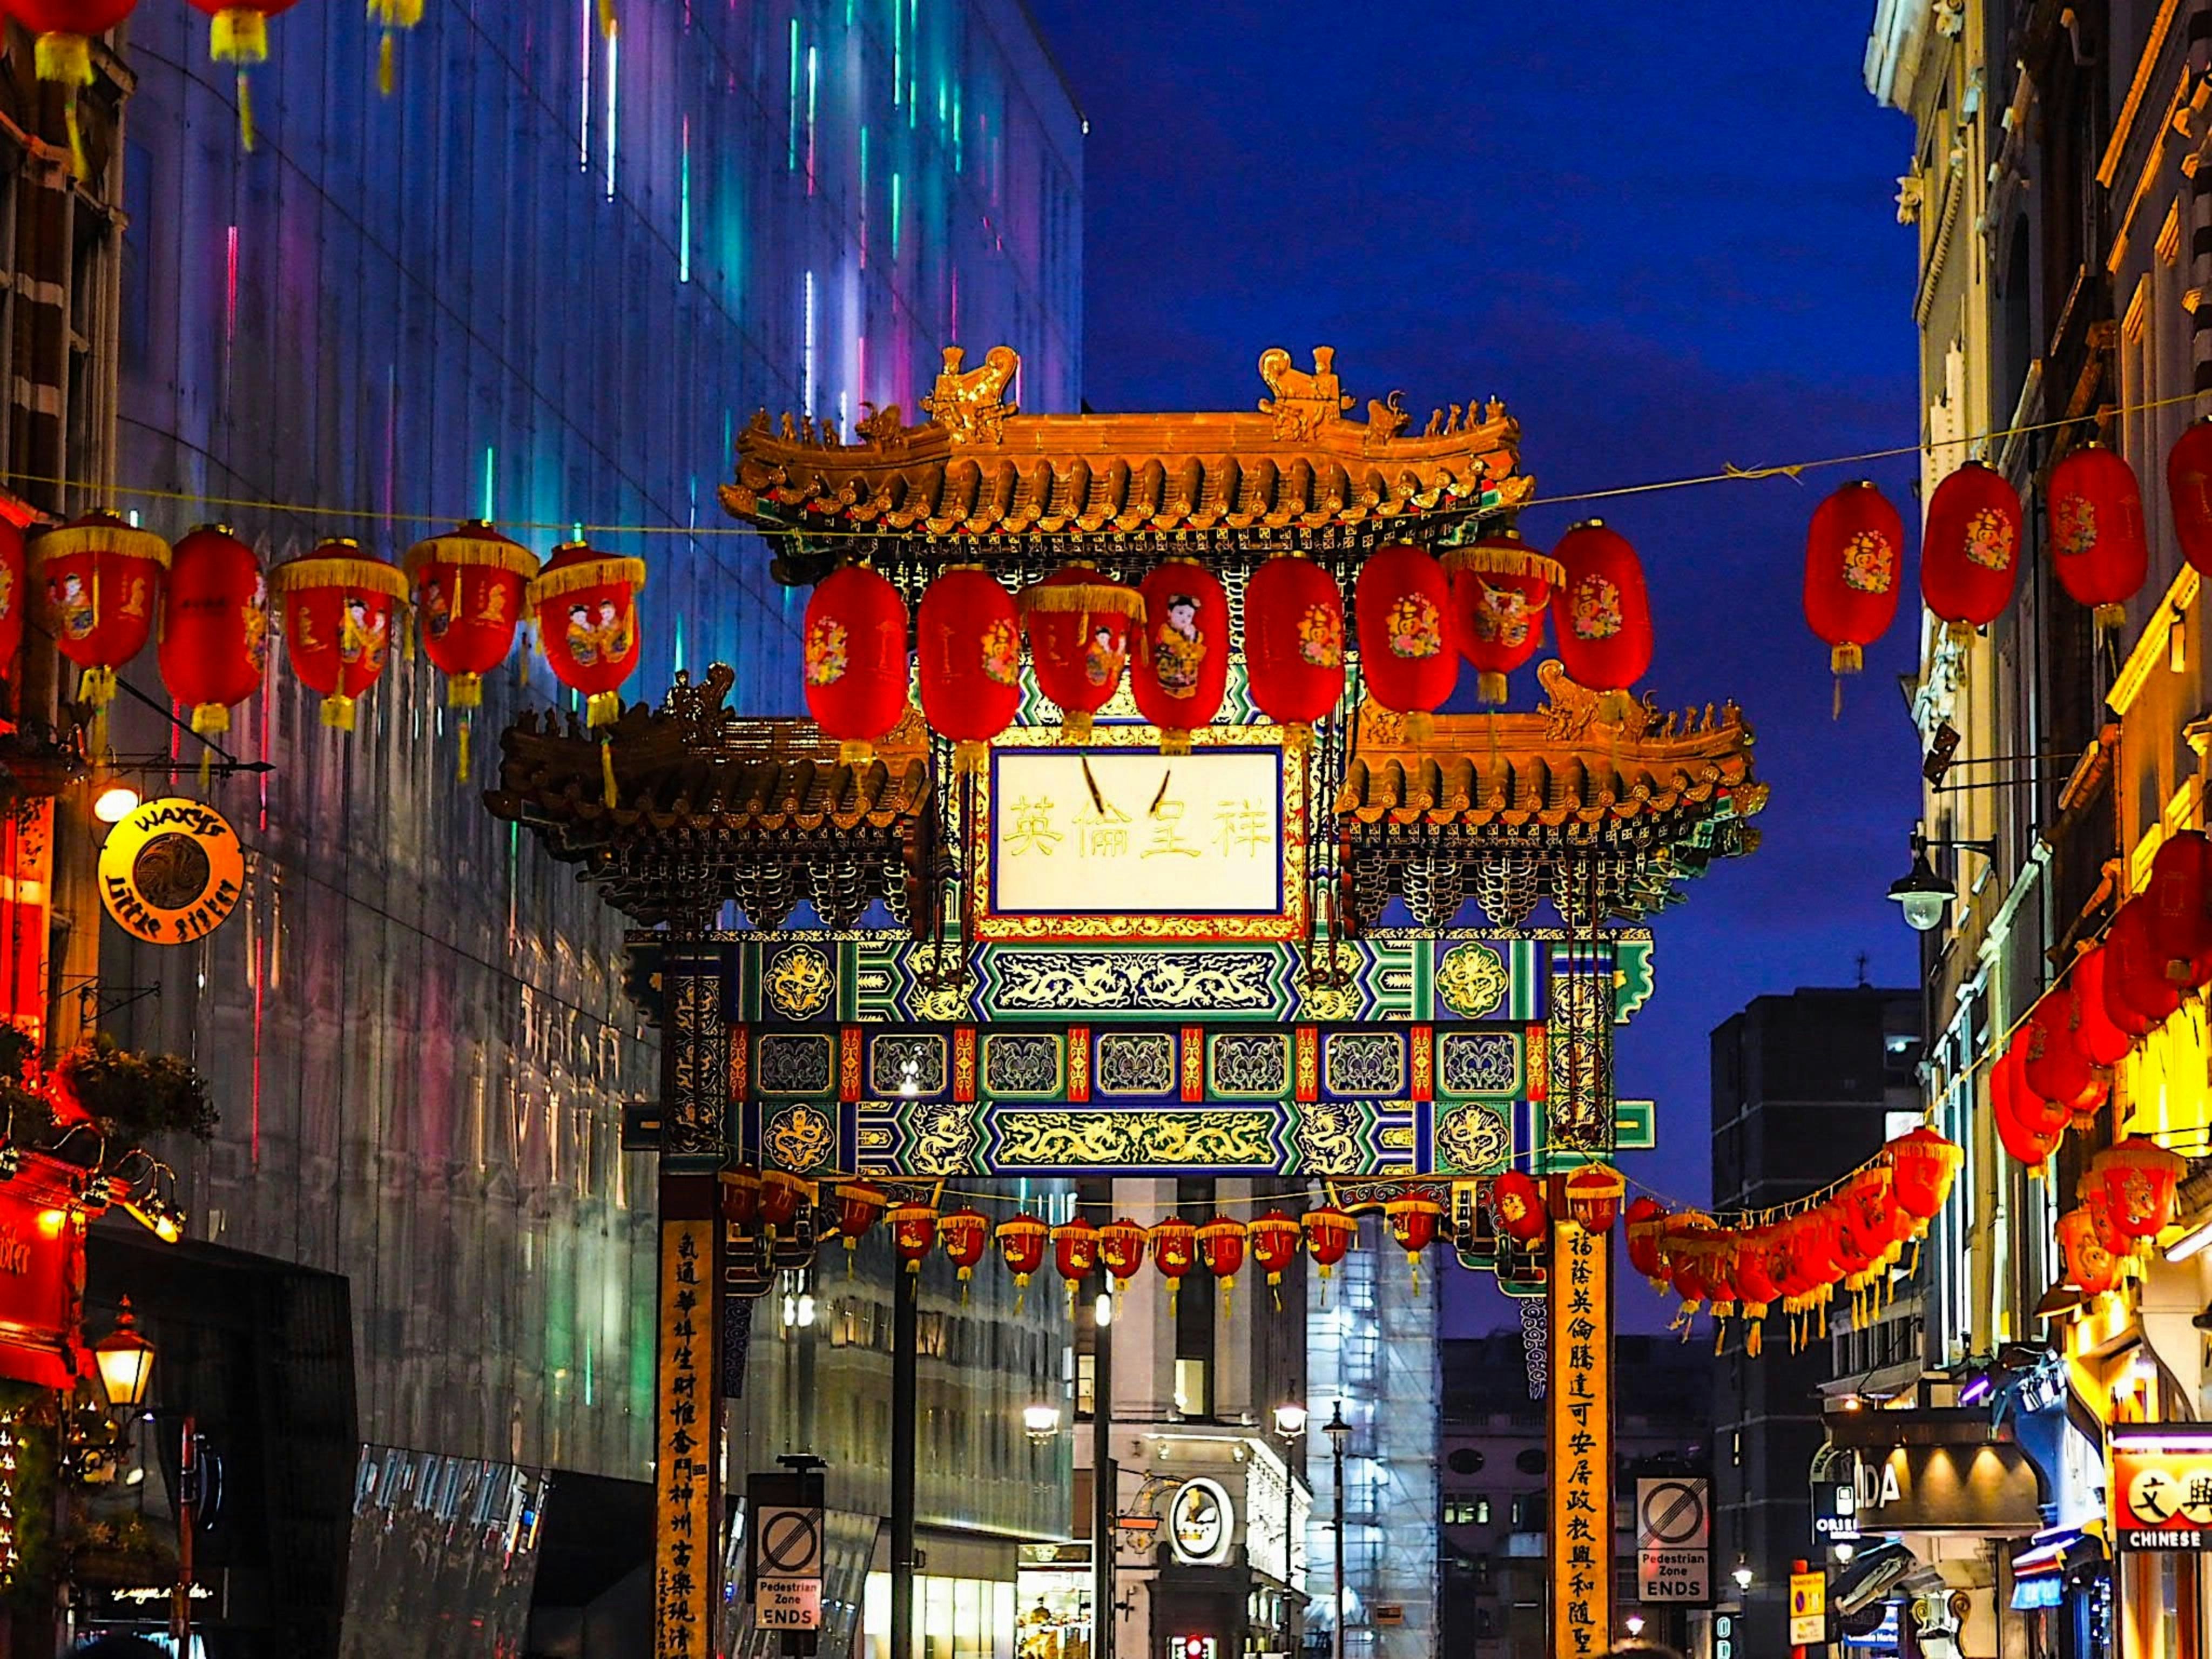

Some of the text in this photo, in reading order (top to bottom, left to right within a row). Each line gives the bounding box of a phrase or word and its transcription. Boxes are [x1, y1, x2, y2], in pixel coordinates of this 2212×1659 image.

[1002, 794, 1272, 858] 英倫呈祥
[2130, 1530, 2201, 1547] CHINESE
[1643, 1553, 1705, 1564] Pedestrian
[1659, 1566, 1688, 1576] Zone
[760, 1581, 817, 1592] Pedestrian
[1647, 1581, 1701, 1596] ENDS
[774, 1594, 801, 1604] Zone
[764, 1609, 812, 1624] ENDS
